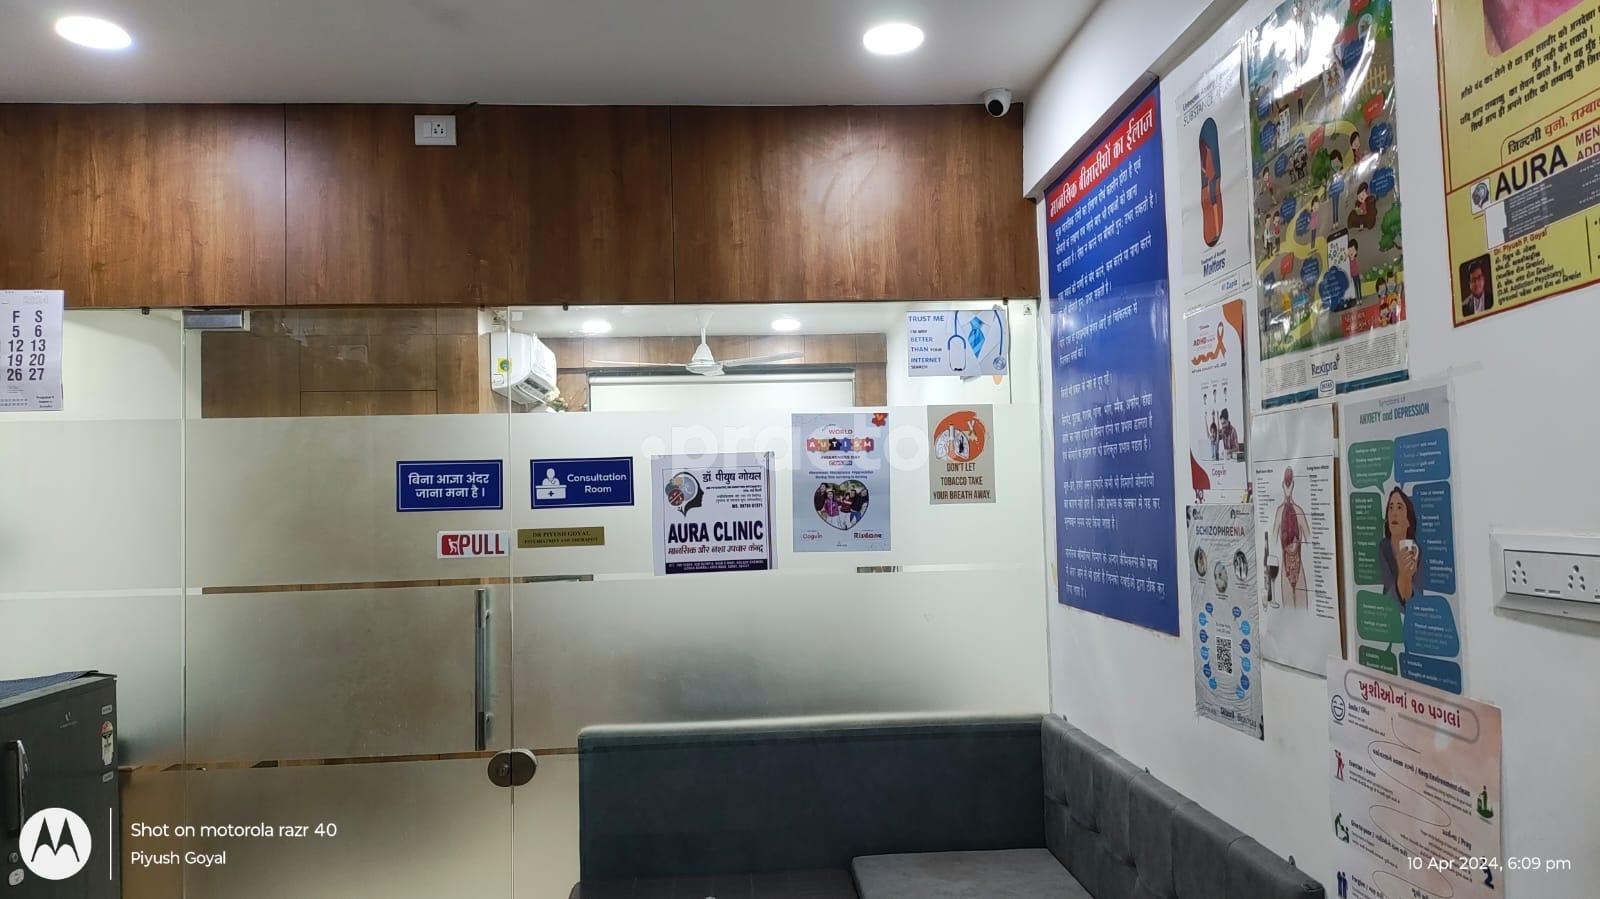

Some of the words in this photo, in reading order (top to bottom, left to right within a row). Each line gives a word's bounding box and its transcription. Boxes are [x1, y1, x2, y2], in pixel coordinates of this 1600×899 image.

[1558, 26, 1567, 38] को
[1508, 87, 1518, 96] का
[1563, 54, 1571, 65] तो
[1485, 112, 1496, 125] आप
[1498, 104, 1505, 119] ही
[1507, 96, 1522, 113] अपने
[1540, 81, 1548, 92] को
[1574, 60, 1585, 71] की
[1508, 127, 1541, 155] जिन्दगी
[1050, 178, 1077, 218] मानसिक
[1113, 136, 1124, 158] का
[1126, 108, 1152, 153] ईलाज
[1495, 144, 1568, 201] AURA
[1530, 230, 1548, 243] Goyal
[1204, 257, 1226, 277] Matters
[13, 310, 20, 323] F
[35, 310, 43, 323] S
[12, 325, 20, 338] 5
[35, 325, 42, 338] 6
[8, 340, 24, 352] 12
[32, 340, 46, 352] 13
[8, 354, 23, 366] 19
[29, 354, 45, 366] 20
[1312, 359, 1338, 376] Rexipra
[7, 368, 23, 381] 26
[29, 368, 45, 381] 27
[1360, 412, 1381, 425] ANXIETY
[1382, 412, 1393, 421] and
[1394, 402, 1430, 420] DEPRESSION
[946, 463, 964, 472] DON'T
[965, 462, 976, 472] LET
[408, 472, 434, 485] बिना
[436, 474, 463, 485] आज्ञा
[466, 472, 490, 485] अंदर
[567, 472, 627, 483] Consultation
[738, 470, 762, 481] गोयल
[940, 477, 967, 486] TOBACCO
[968, 476, 984, 485] TAKE
[416, 488, 442, 498] जाना
[446, 487, 469, 498] मना
[472, 485, 479, 499] है
[584, 485, 612, 494] Room
[933, 491, 949, 500] YOUR
[950, 490, 973, 500] BREATH
[974, 490, 991, 500] AWAY.
[668, 522, 710, 544] AURA
[714, 520, 764, 542] CLINIC
[1196, 526, 1245, 538] SCHIZOPHRENIA
[459, 534, 505, 555] PULL
[668, 544, 697, 555] मानसिक
[698, 544, 710, 554] और
[711, 544, 726, 553] नशा
[727, 544, 747, 554] उपचार
[1359, 680, 1407, 710] ખુશીઓનાં
[1411, 700, 1425, 715] ૧૦
[1429, 704, 1461, 729] પગલાં
